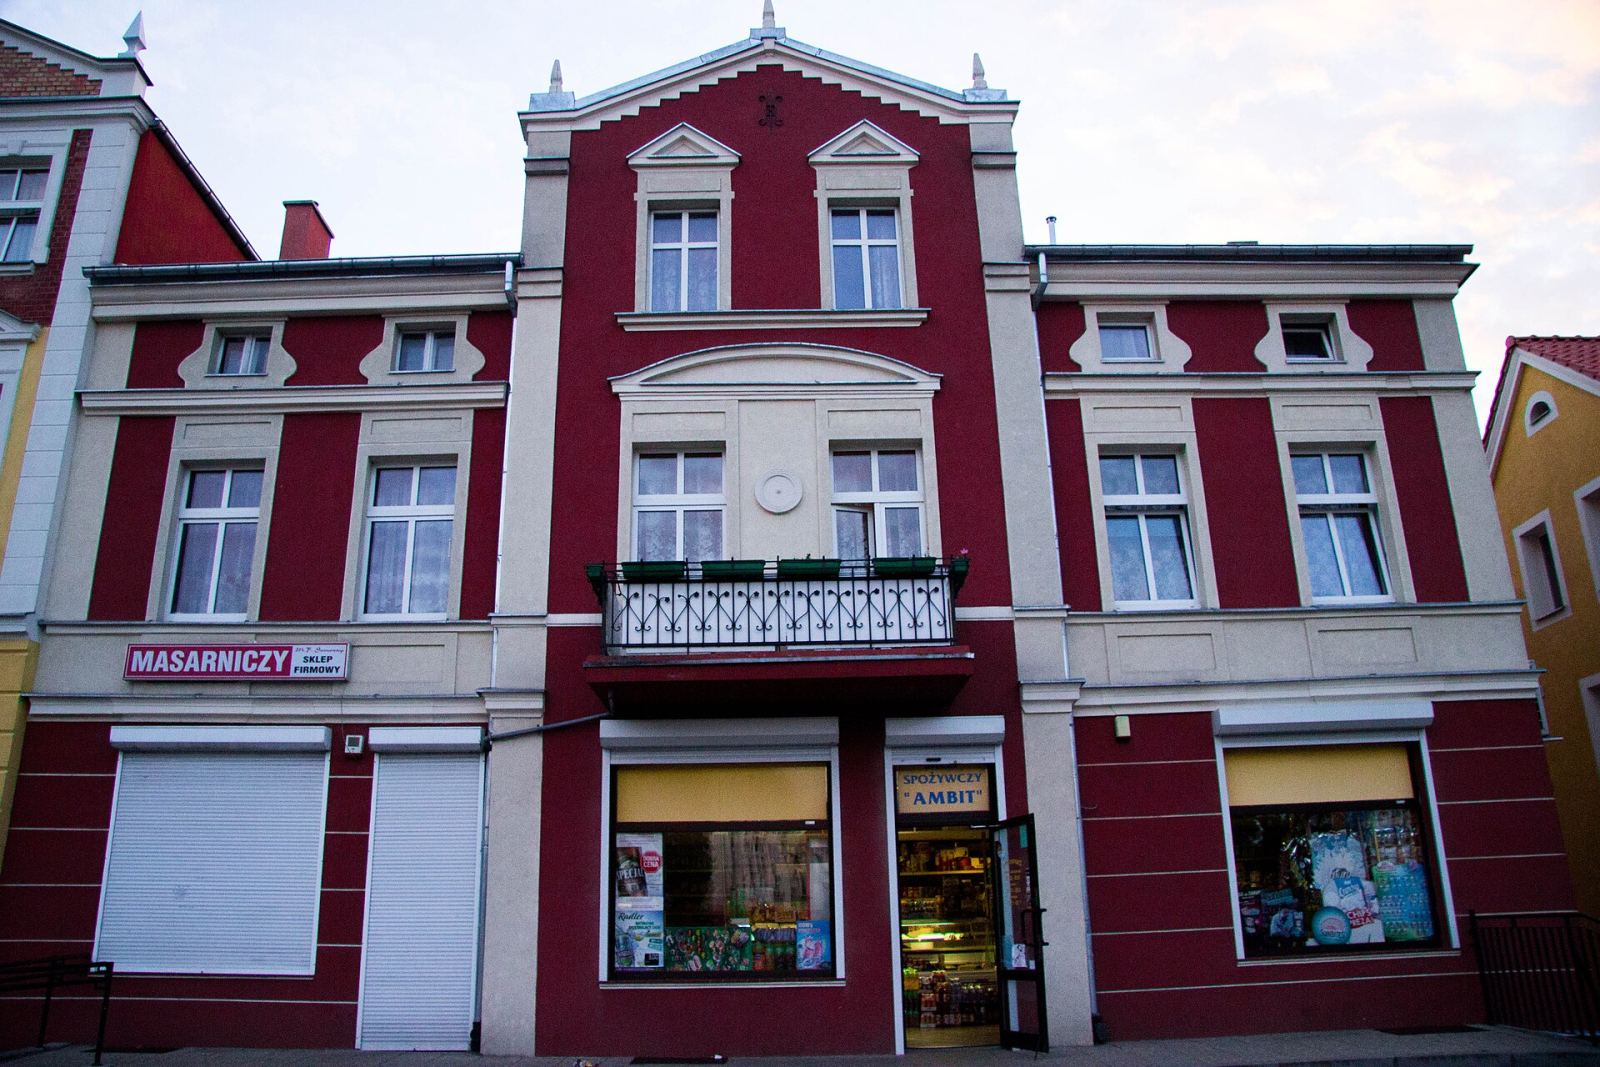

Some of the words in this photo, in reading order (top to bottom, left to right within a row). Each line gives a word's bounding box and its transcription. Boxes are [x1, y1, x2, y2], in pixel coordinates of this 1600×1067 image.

[131, 650, 289, 673] MASARNICZY
[303, 655, 333, 664] SKLEP
[294, 666, 340, 674] FIRMOWY
[903, 772, 982, 785] SPOŻYWCZY
